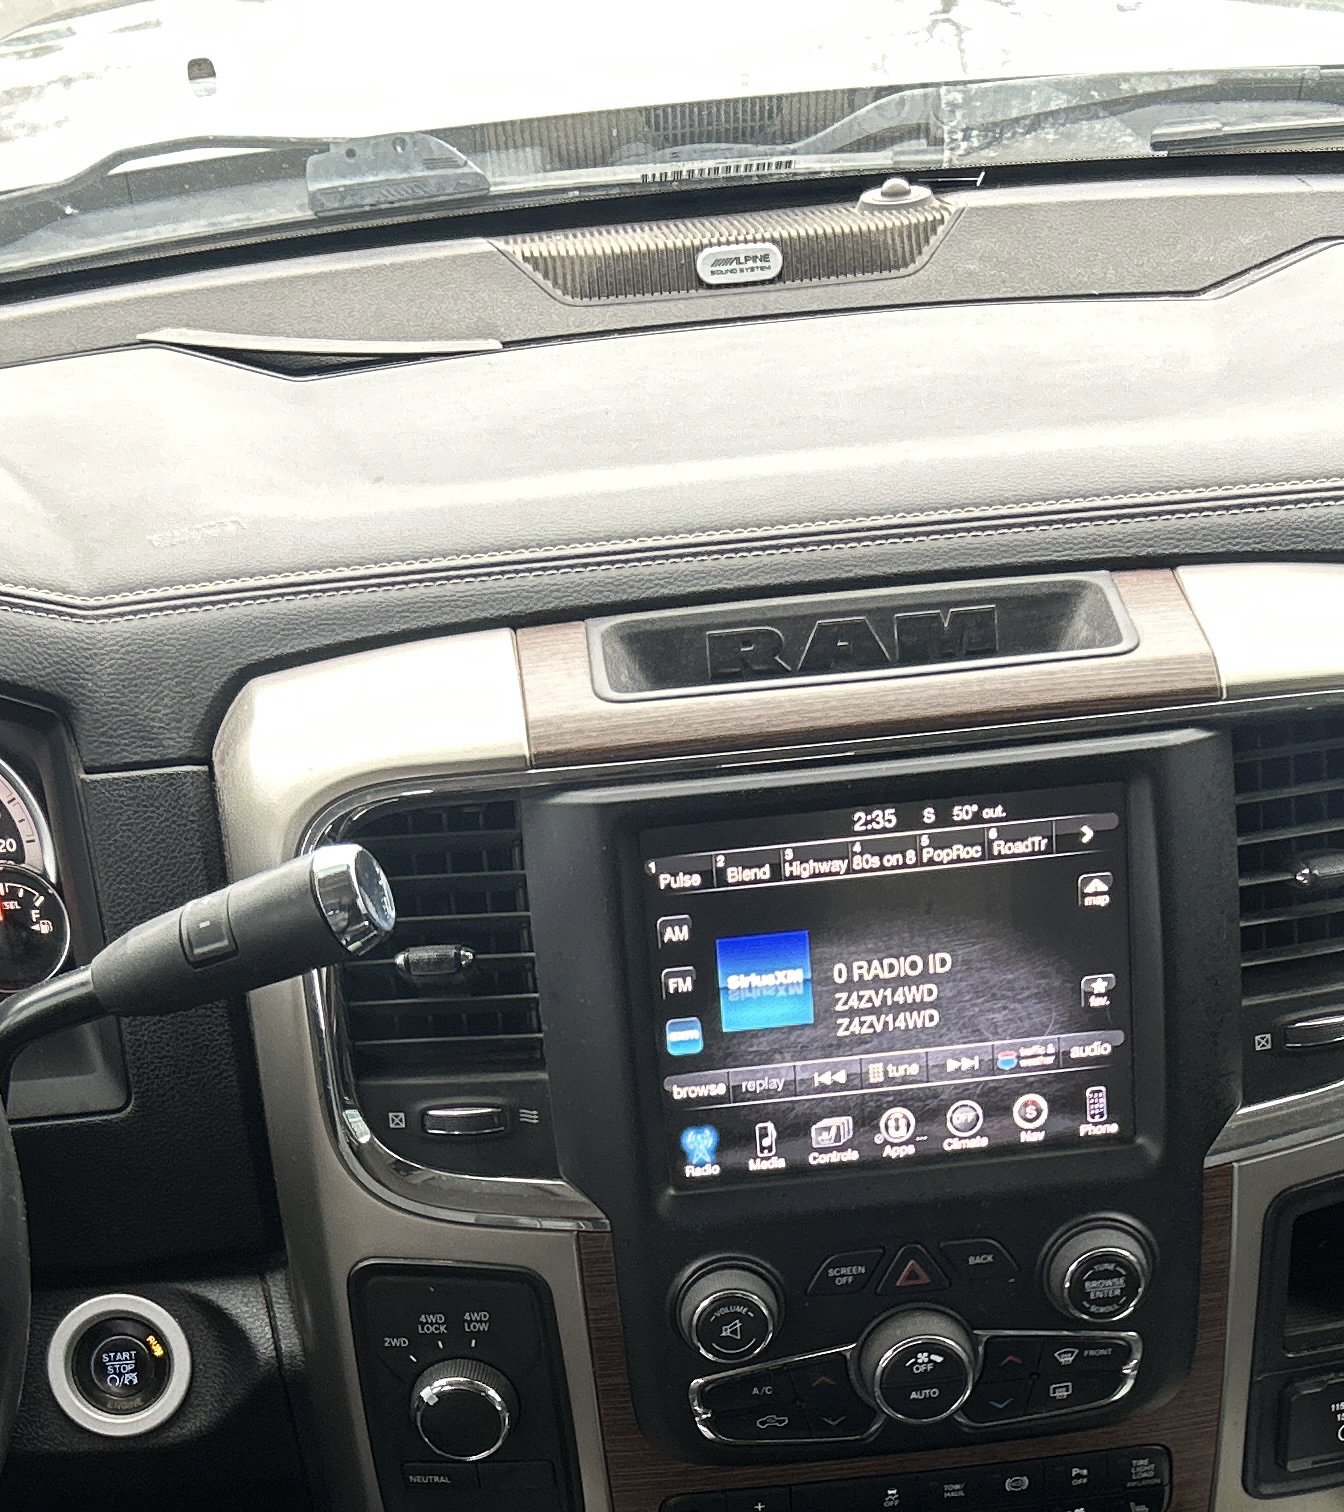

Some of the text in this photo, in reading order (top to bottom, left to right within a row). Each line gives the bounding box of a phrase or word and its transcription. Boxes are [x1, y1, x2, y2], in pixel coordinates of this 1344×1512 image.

[711, 253, 771, 268] ALPINE
[710, 264, 772, 276] SOUND SYSTEM
[706, 604, 999, 680] RAM
[853, 808, 897, 831] 2:35
[922, 807, 936, 823] S
[982, 805, 1007, 819] out.
[992, 836, 1048, 856] RoadTr
[716, 855, 726, 867] 2
[852, 850, 917, 870] 80s on 8
[922, 844, 982, 864] PopRoc
[726, 863, 771, 883] Blend
[784, 858, 849, 879] Highway
[659, 873, 702, 890] Pulse
[31, 910, 41, 922] F
[664, 925, 689, 943] AM
[852, 954, 924, 982] RADIO
[928, 952, 952, 974] ID
[668, 976, 693, 994] FM
[726, 968, 804, 991] SiriusXM
[834, 983, 939, 1012] Z4ZV14WD
[836, 1008, 940, 1037] Z4ZV14WD
[1070, 1040, 1112, 1059] audio
[886, 1061, 920, 1078] tune
[672, 1082, 727, 1100] browse
[742, 1076, 786, 1094] replay
[1020, 1129, 1046, 1143] Nav
[1079, 1122, 1119, 1137] Phone
[882, 1143, 916, 1158] Apps
[943, 1135, 989, 1152] Climate
[748, 1156, 786, 1172] Media
[808, 1149, 859, 1166] Controls
[685, 1163, 721, 1178] Radio
[967, 1254, 994, 1265] BACK
[827, 1265, 866, 1278] SCREEN
[834, 1275, 854, 1287] OFF
[419, 1314, 445, 1323] 4WD
[463, 1311, 490, 1321] 4WD
[714, 1305, 749, 1318] VOLUME
[417, 1324, 448, 1334] LOCK
[464, 1322, 490, 1332] LOW
[383, 1337, 409, 1347] 2WD
[102, 1350, 137, 1362] START
[1083, 1347, 1113, 1357] FRONT
[107, 1363, 136, 1375] STOP
[913, 1362, 934, 1374] OFF
[752, 1385, 773, 1396] A/C
[909, 1388, 940, 1400] AUTO
[408, 1474, 452, 1484] NEUTRAL
